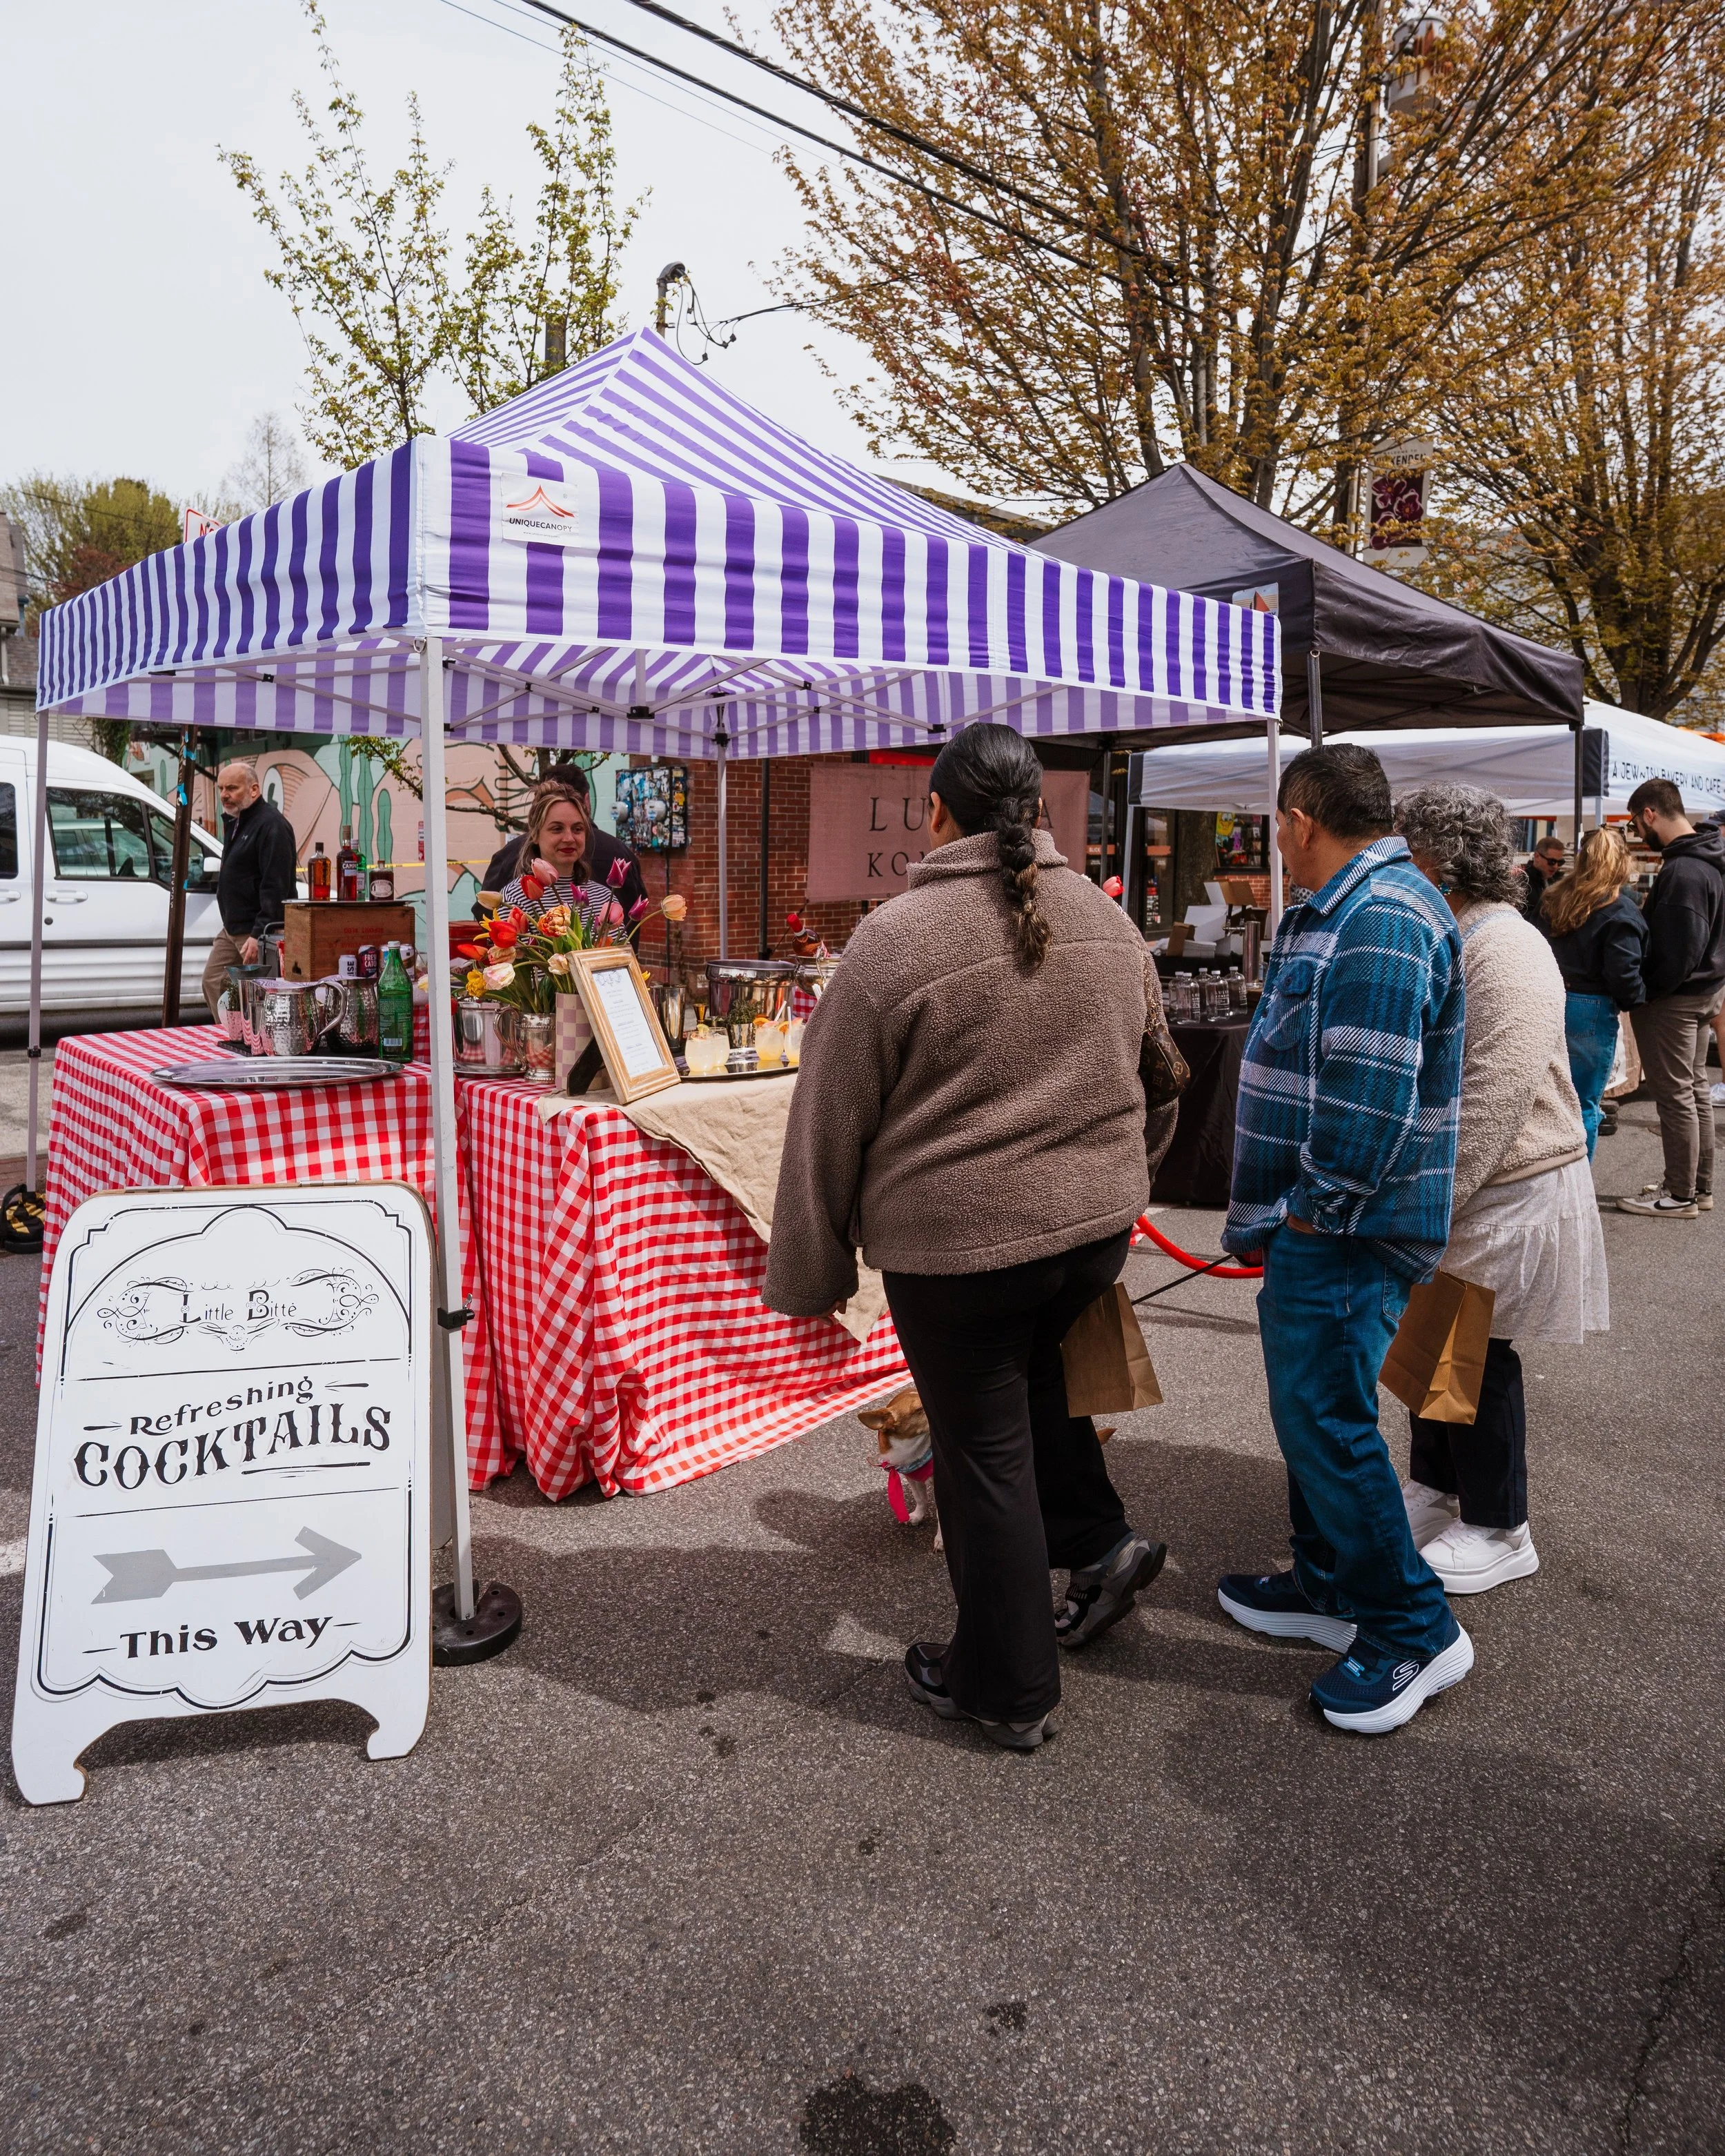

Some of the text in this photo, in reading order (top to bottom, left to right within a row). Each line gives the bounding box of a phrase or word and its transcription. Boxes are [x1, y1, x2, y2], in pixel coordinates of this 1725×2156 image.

[509, 517, 572, 532] UNIQUECANOPY
[1612, 761, 1618, 779] A
[1691, 774, 1704, 791] AND
[1705, 777, 1722, 793] CAFE
[179, 1294, 234, 1323] Little
[130, 1376, 313, 1436] Refreshing
[72, 1403, 391, 1490] COCKTAILS
[119, 1616, 334, 1659] This Way
